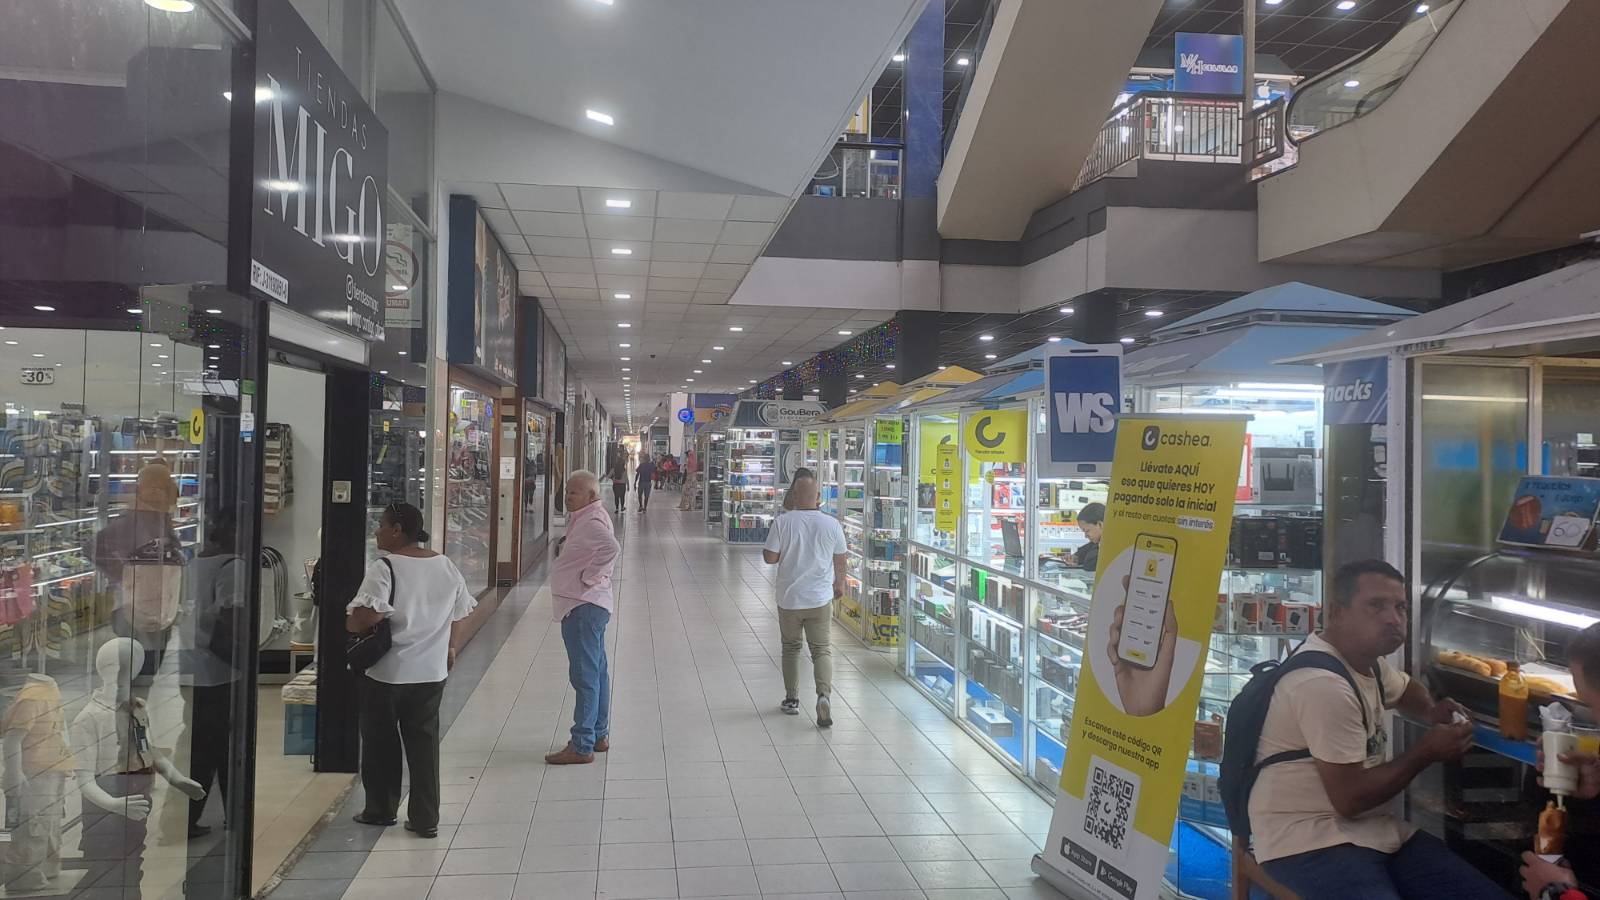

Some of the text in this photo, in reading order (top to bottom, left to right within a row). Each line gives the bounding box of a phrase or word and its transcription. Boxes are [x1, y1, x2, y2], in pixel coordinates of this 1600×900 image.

[296, 46, 367, 150] TIENDAS
[264, 73, 382, 277] MIGO
[1324, 378, 1374, 402] nacks
[1055, 392, 1115, 434] WS
[1121, 478, 1216, 494] eso que quieres HOY
[1140, 461, 1201, 477] Llévate AQUÍ
[1113, 492, 1218, 512] pagando solo la inicial
[1082, 729, 1087, 739] y
[1087, 731, 1118, 751] descarga
[1145, 758, 1160, 771] app
[1085, 716, 1162, 756] Escanea este código QR
